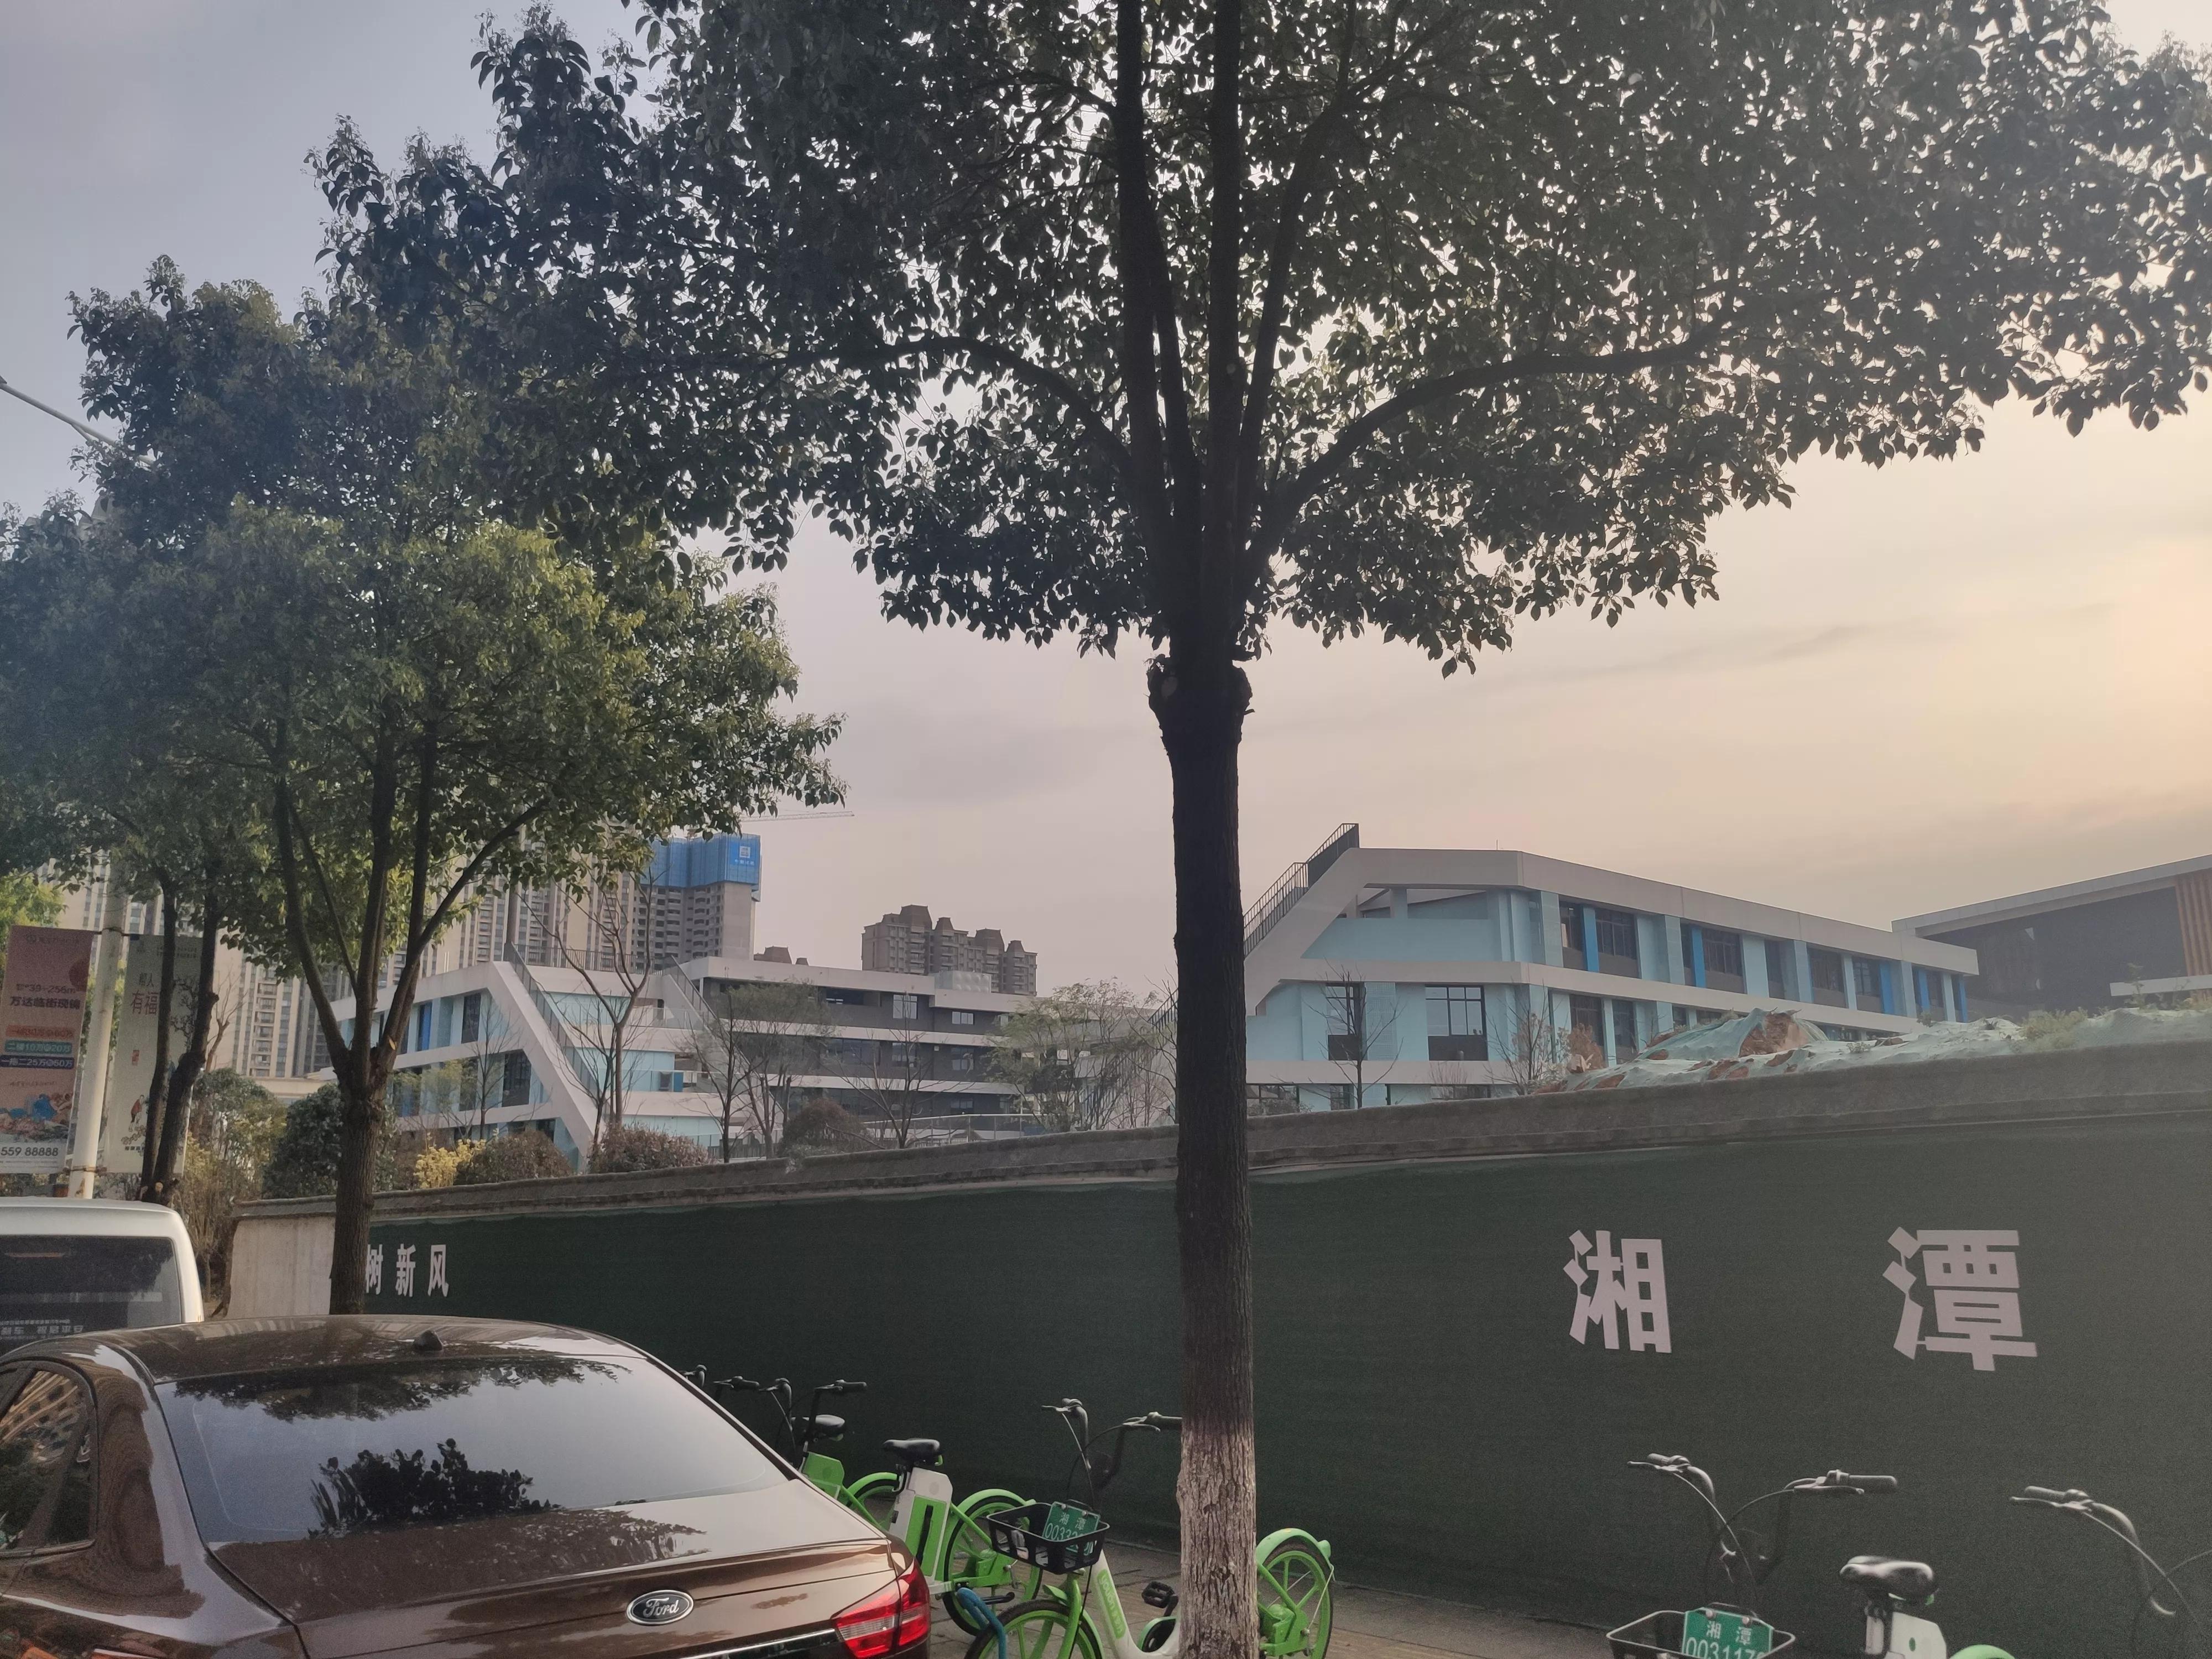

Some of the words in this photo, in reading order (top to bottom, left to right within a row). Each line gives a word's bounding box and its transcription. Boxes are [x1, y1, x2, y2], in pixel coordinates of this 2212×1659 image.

[131, 990, 159, 1015] 有福
[25, 1147, 59, 1156] 88888
[366, 1243, 449, 1297] 树新风
[1059, 1512, 1086, 1531] 湘潭
[643, 1597, 680, 1618] Ford
[1706, 1620, 1753, 1645] 湘潭
